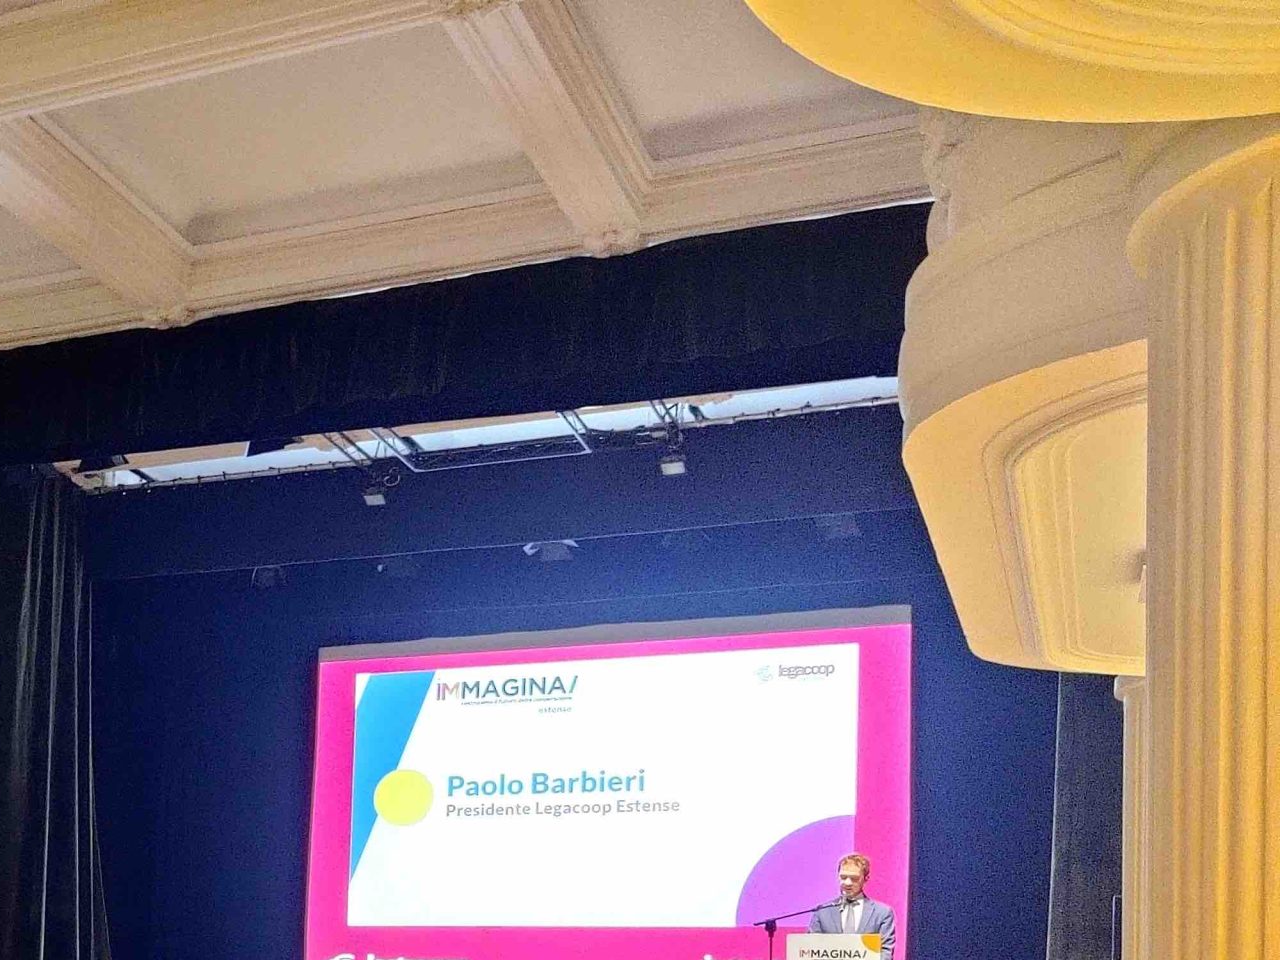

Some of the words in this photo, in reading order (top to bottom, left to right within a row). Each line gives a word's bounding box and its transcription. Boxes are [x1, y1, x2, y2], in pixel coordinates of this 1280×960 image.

[447, 773, 524, 797] Paolo
[531, 769, 645, 794] Barbieri
[446, 802, 530, 816] Presidente
[535, 801, 612, 817] Legacoop
[616, 799, 680, 813] Estense
